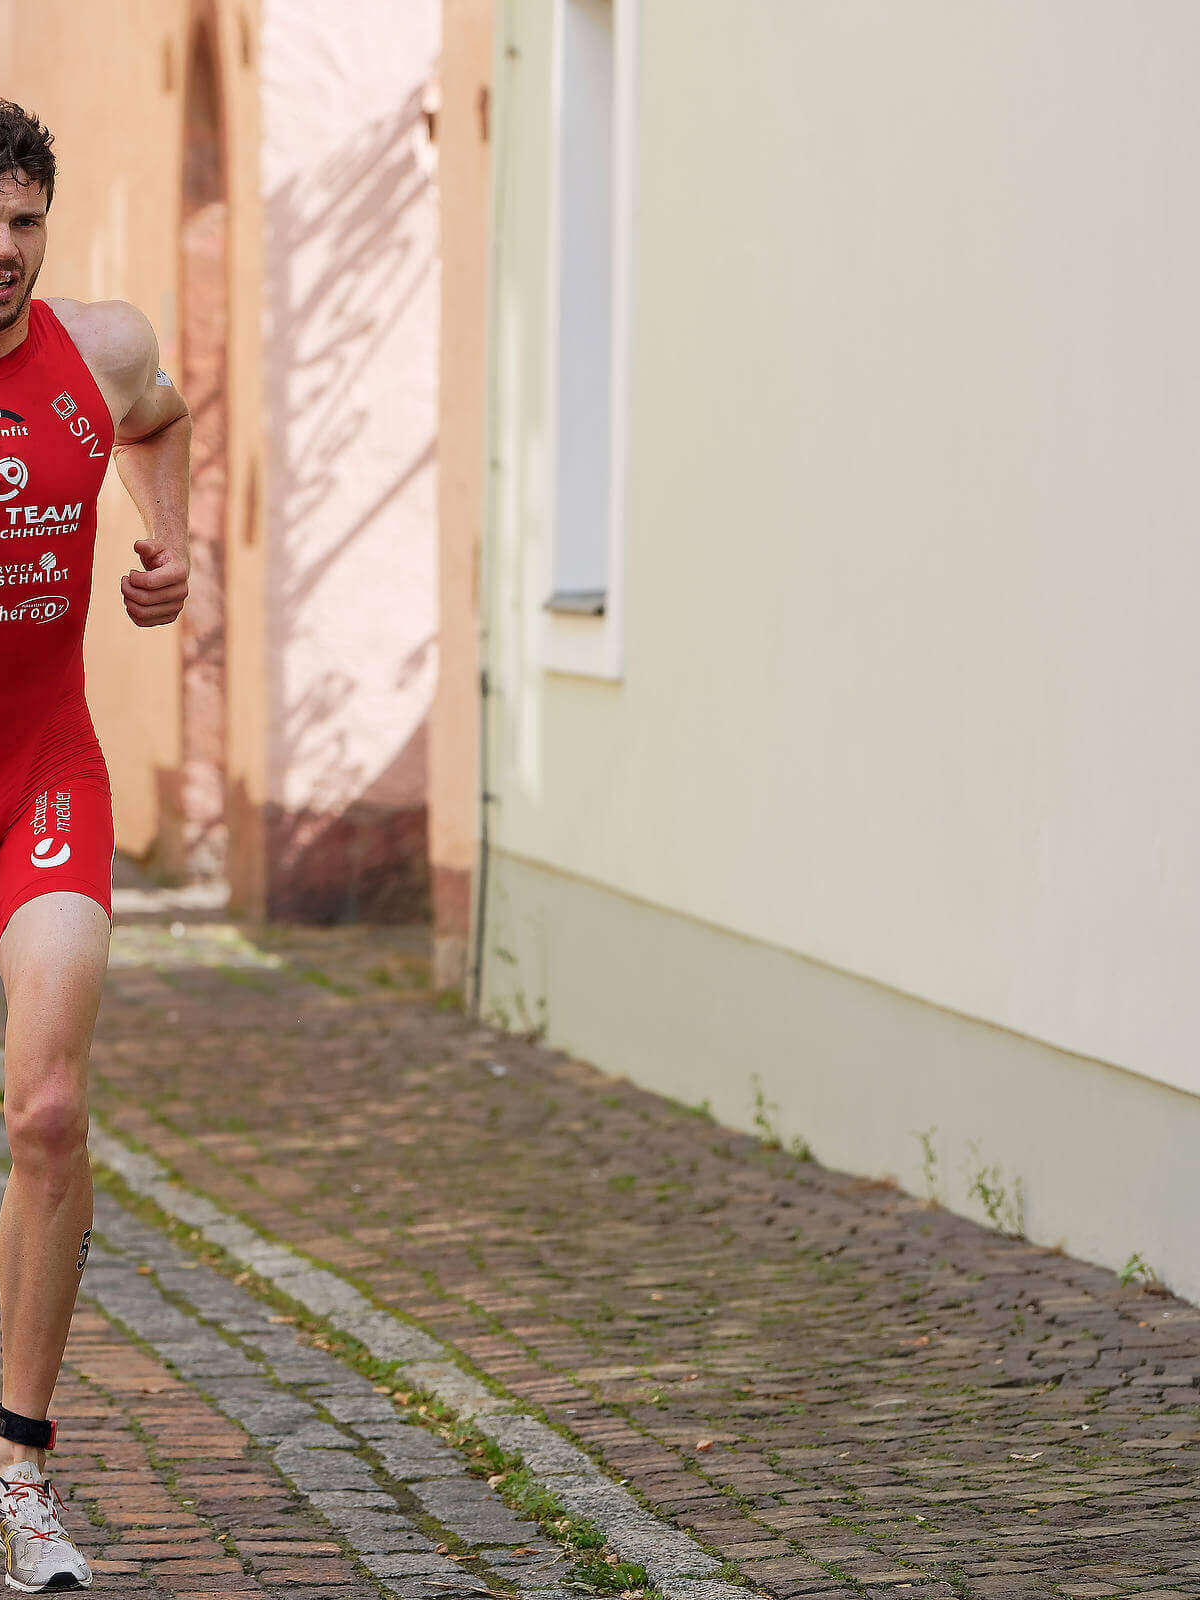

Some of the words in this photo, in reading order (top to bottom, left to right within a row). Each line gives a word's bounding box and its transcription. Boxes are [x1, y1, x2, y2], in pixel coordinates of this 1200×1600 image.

[70, 416, 105, 458] SIV
[6, 502, 82, 525] TEAM
[76, 1229, 91, 1271] 5
